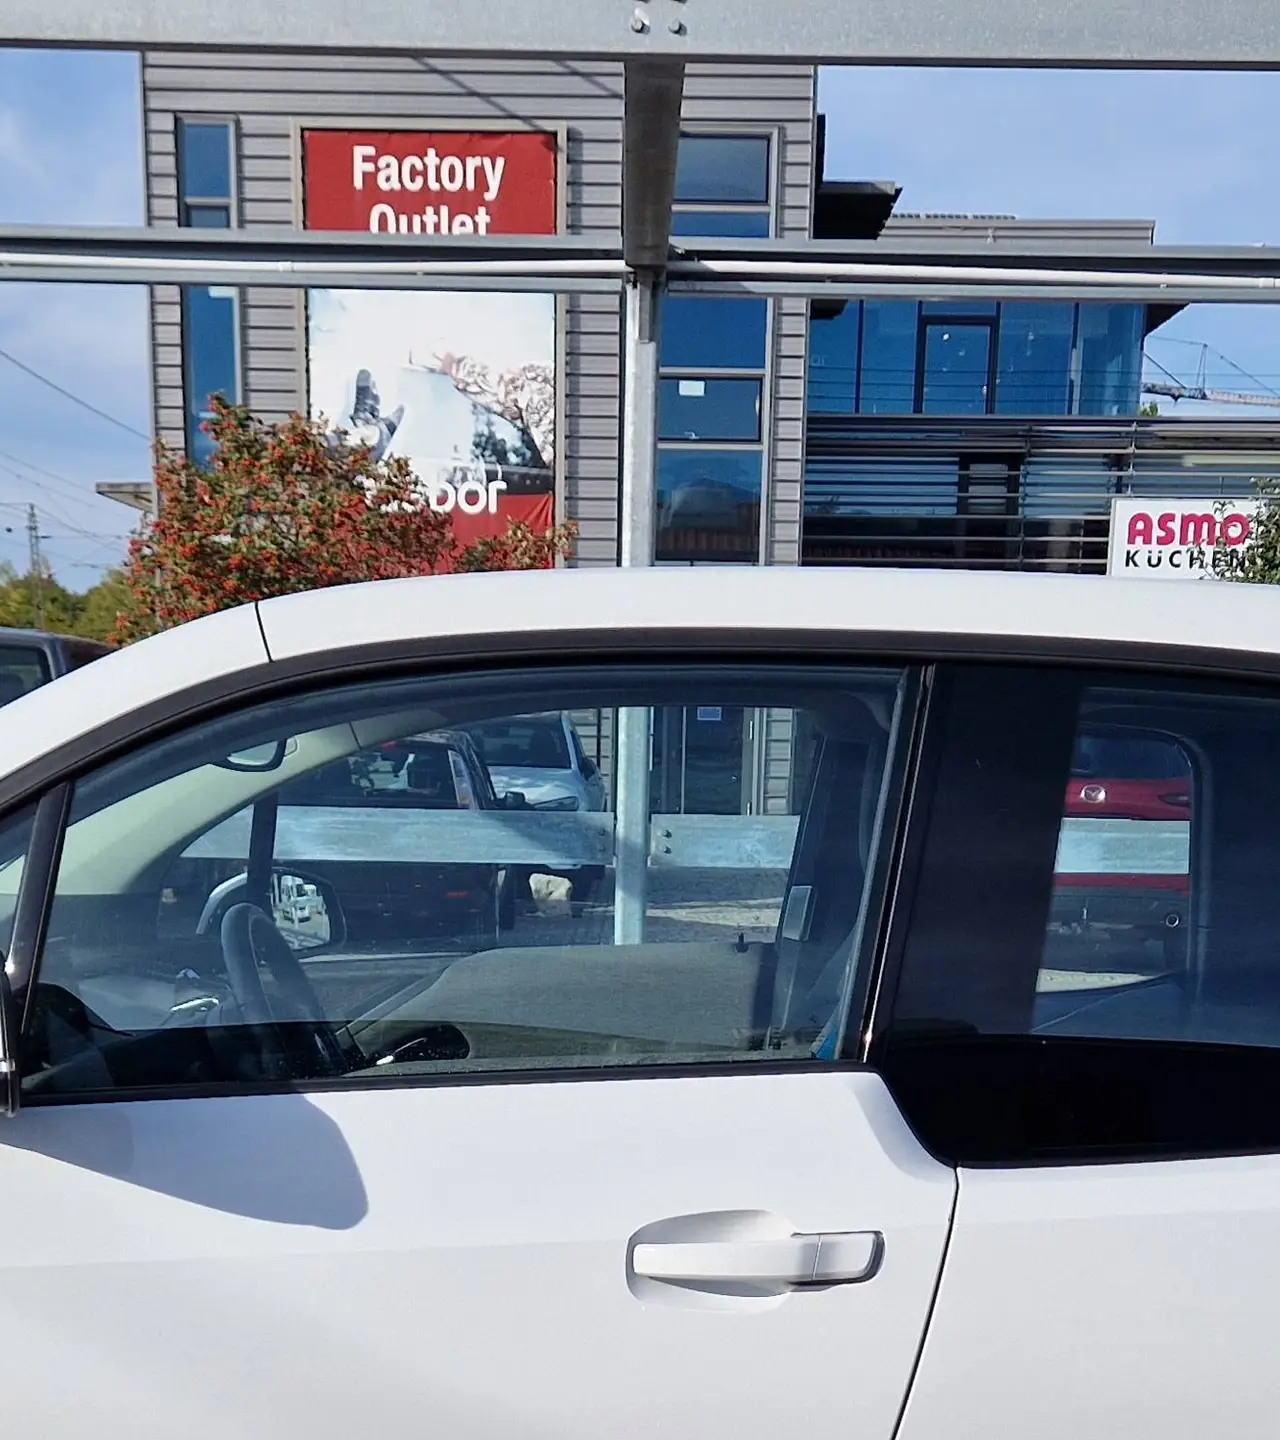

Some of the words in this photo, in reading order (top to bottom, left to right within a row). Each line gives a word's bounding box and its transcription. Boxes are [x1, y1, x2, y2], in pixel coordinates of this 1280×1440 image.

[352, 144, 506, 202] Factory
[370, 203, 491, 236] Outlet
[1127, 512, 1251, 547] ASMO
